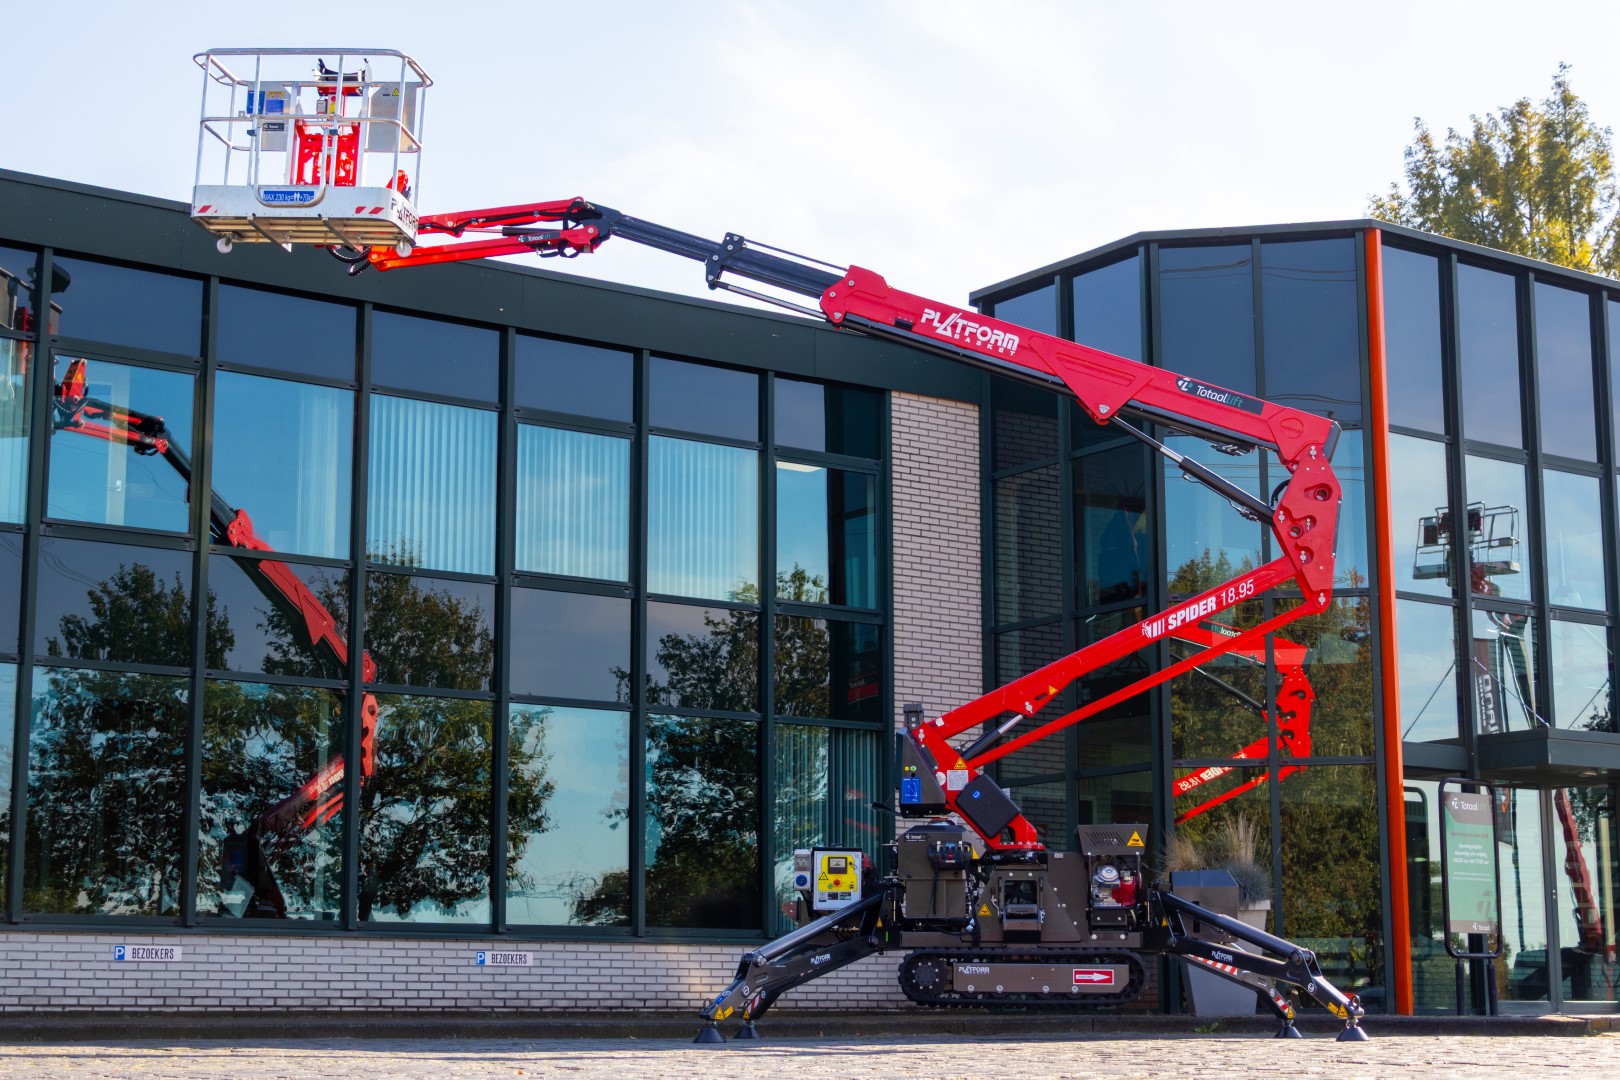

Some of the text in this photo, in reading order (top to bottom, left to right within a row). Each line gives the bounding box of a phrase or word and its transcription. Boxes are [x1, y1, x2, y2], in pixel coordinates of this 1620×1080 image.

[921, 308, 1020, 352] PLATFORM
[954, 334, 1015, 356] BASKET
[1196, 385, 1244, 408] Totaallift
[1168, 579, 1254, 630] SPIDER 18.95
[115, 947, 174, 959] P BEZOEKERS
[478, 952, 527, 964] P BEZOEKERS
